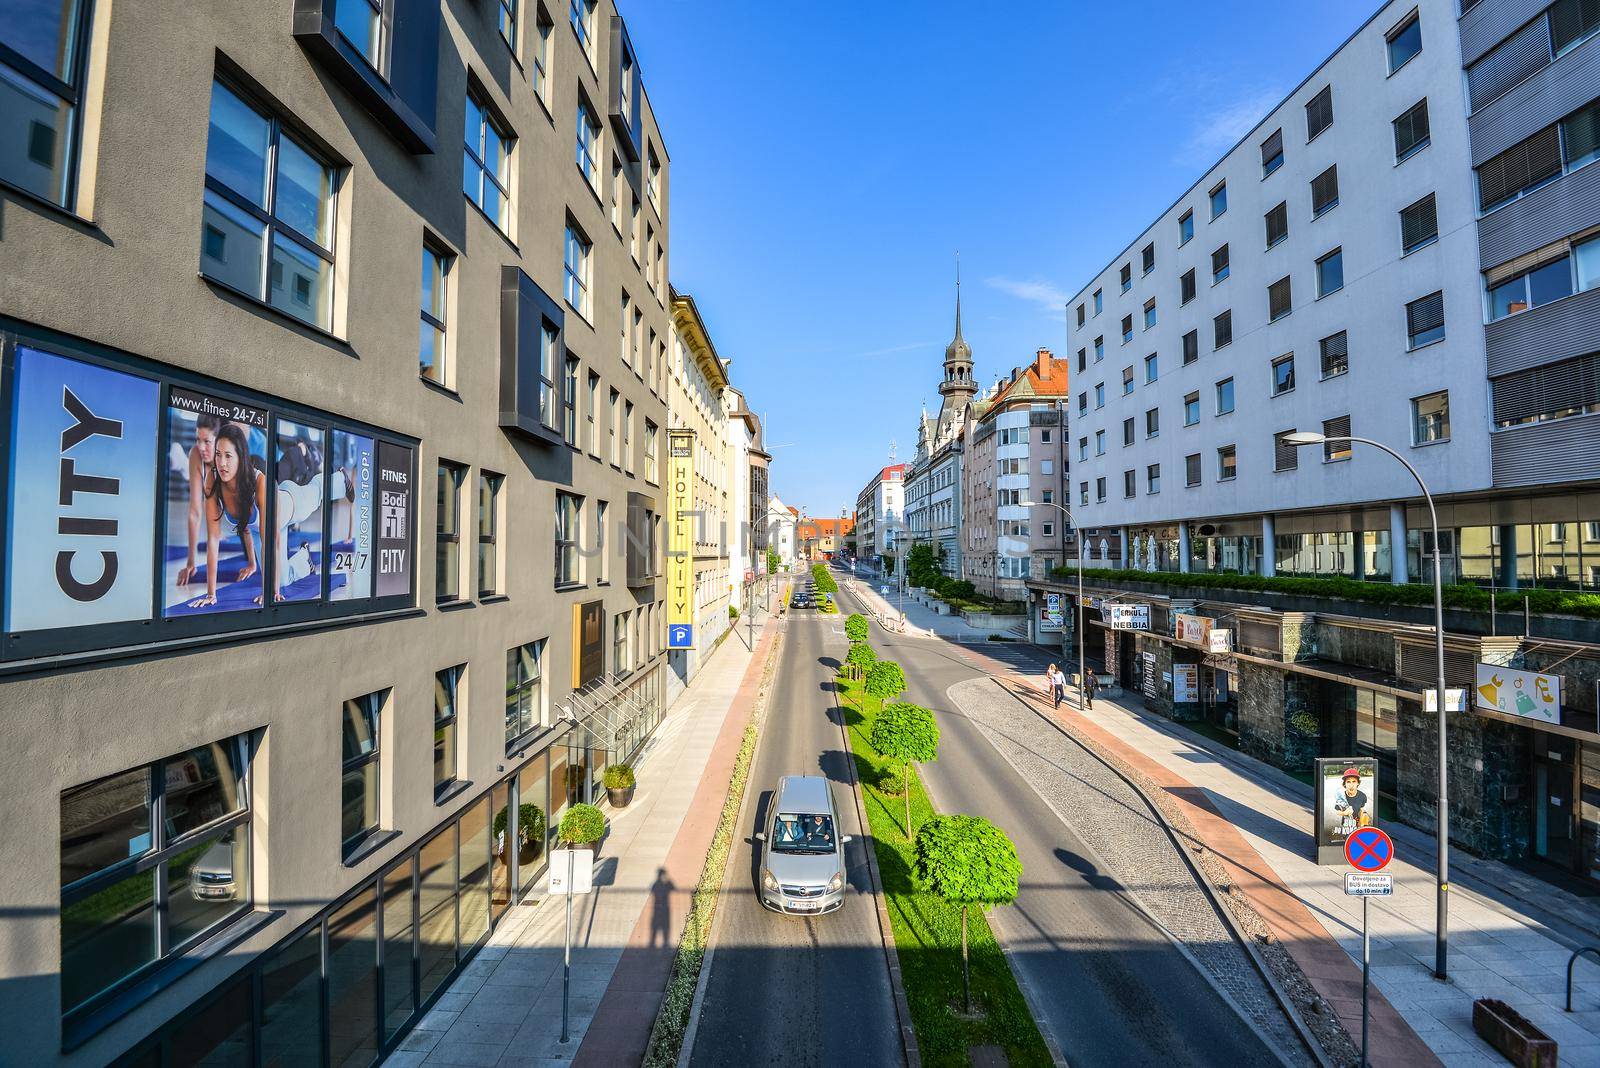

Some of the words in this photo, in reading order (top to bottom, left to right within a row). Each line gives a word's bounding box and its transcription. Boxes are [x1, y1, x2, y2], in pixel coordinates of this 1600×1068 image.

[171, 395, 230, 418] www.fitnes
[233, 406, 264, 426] 24-7.si
[361, 451, 371, 500] STOP!
[381, 469, 407, 485] FITNES
[55, 383, 124, 603] CITY
[382, 491, 407, 508] Bodi
[675, 467, 686, 536] HOTEL
[360, 505, 369, 549] NON
[335, 552, 368, 573] 24/7
[380, 549, 406, 574] CITY
[675, 553, 686, 614] CITY
[676, 631, 686, 642] P
[1113, 621, 1148, 629] NEBBIA
